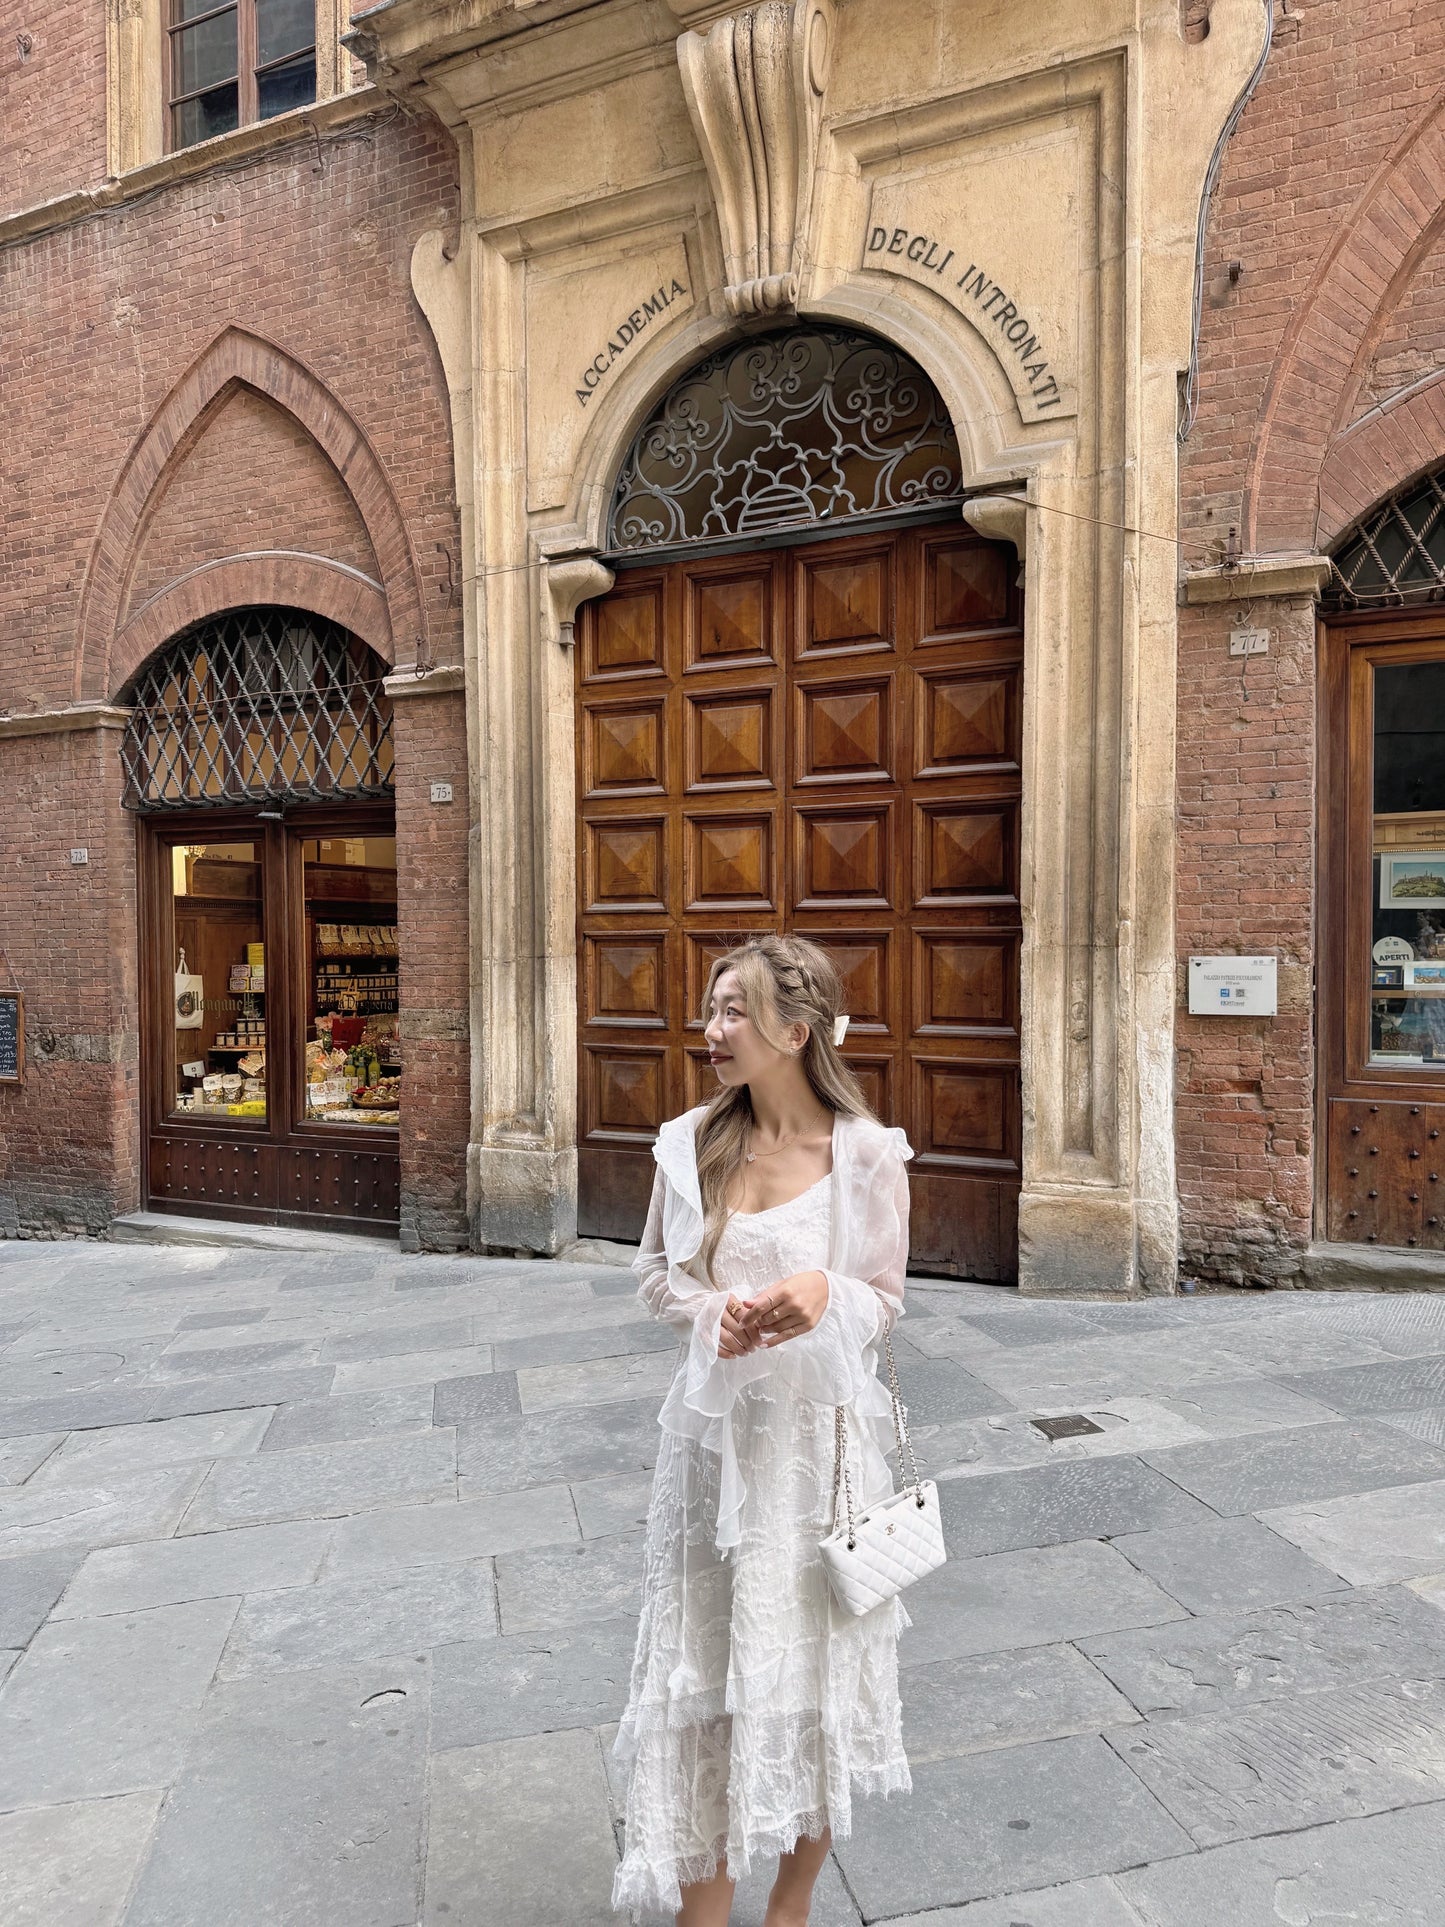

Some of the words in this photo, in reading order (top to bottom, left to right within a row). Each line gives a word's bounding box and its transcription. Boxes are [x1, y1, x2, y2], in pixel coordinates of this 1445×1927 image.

[868, 227, 955, 274] DEGLI
[957, 264, 1061, 410] INTRONATI
[575, 278, 687, 408] ACCADEMIA
[1240, 634, 1258, 650] 77
[436, 786, 448, 799] 75
[74, 850, 83, 862] 73
[1379, 953, 1410, 962] APERTI
